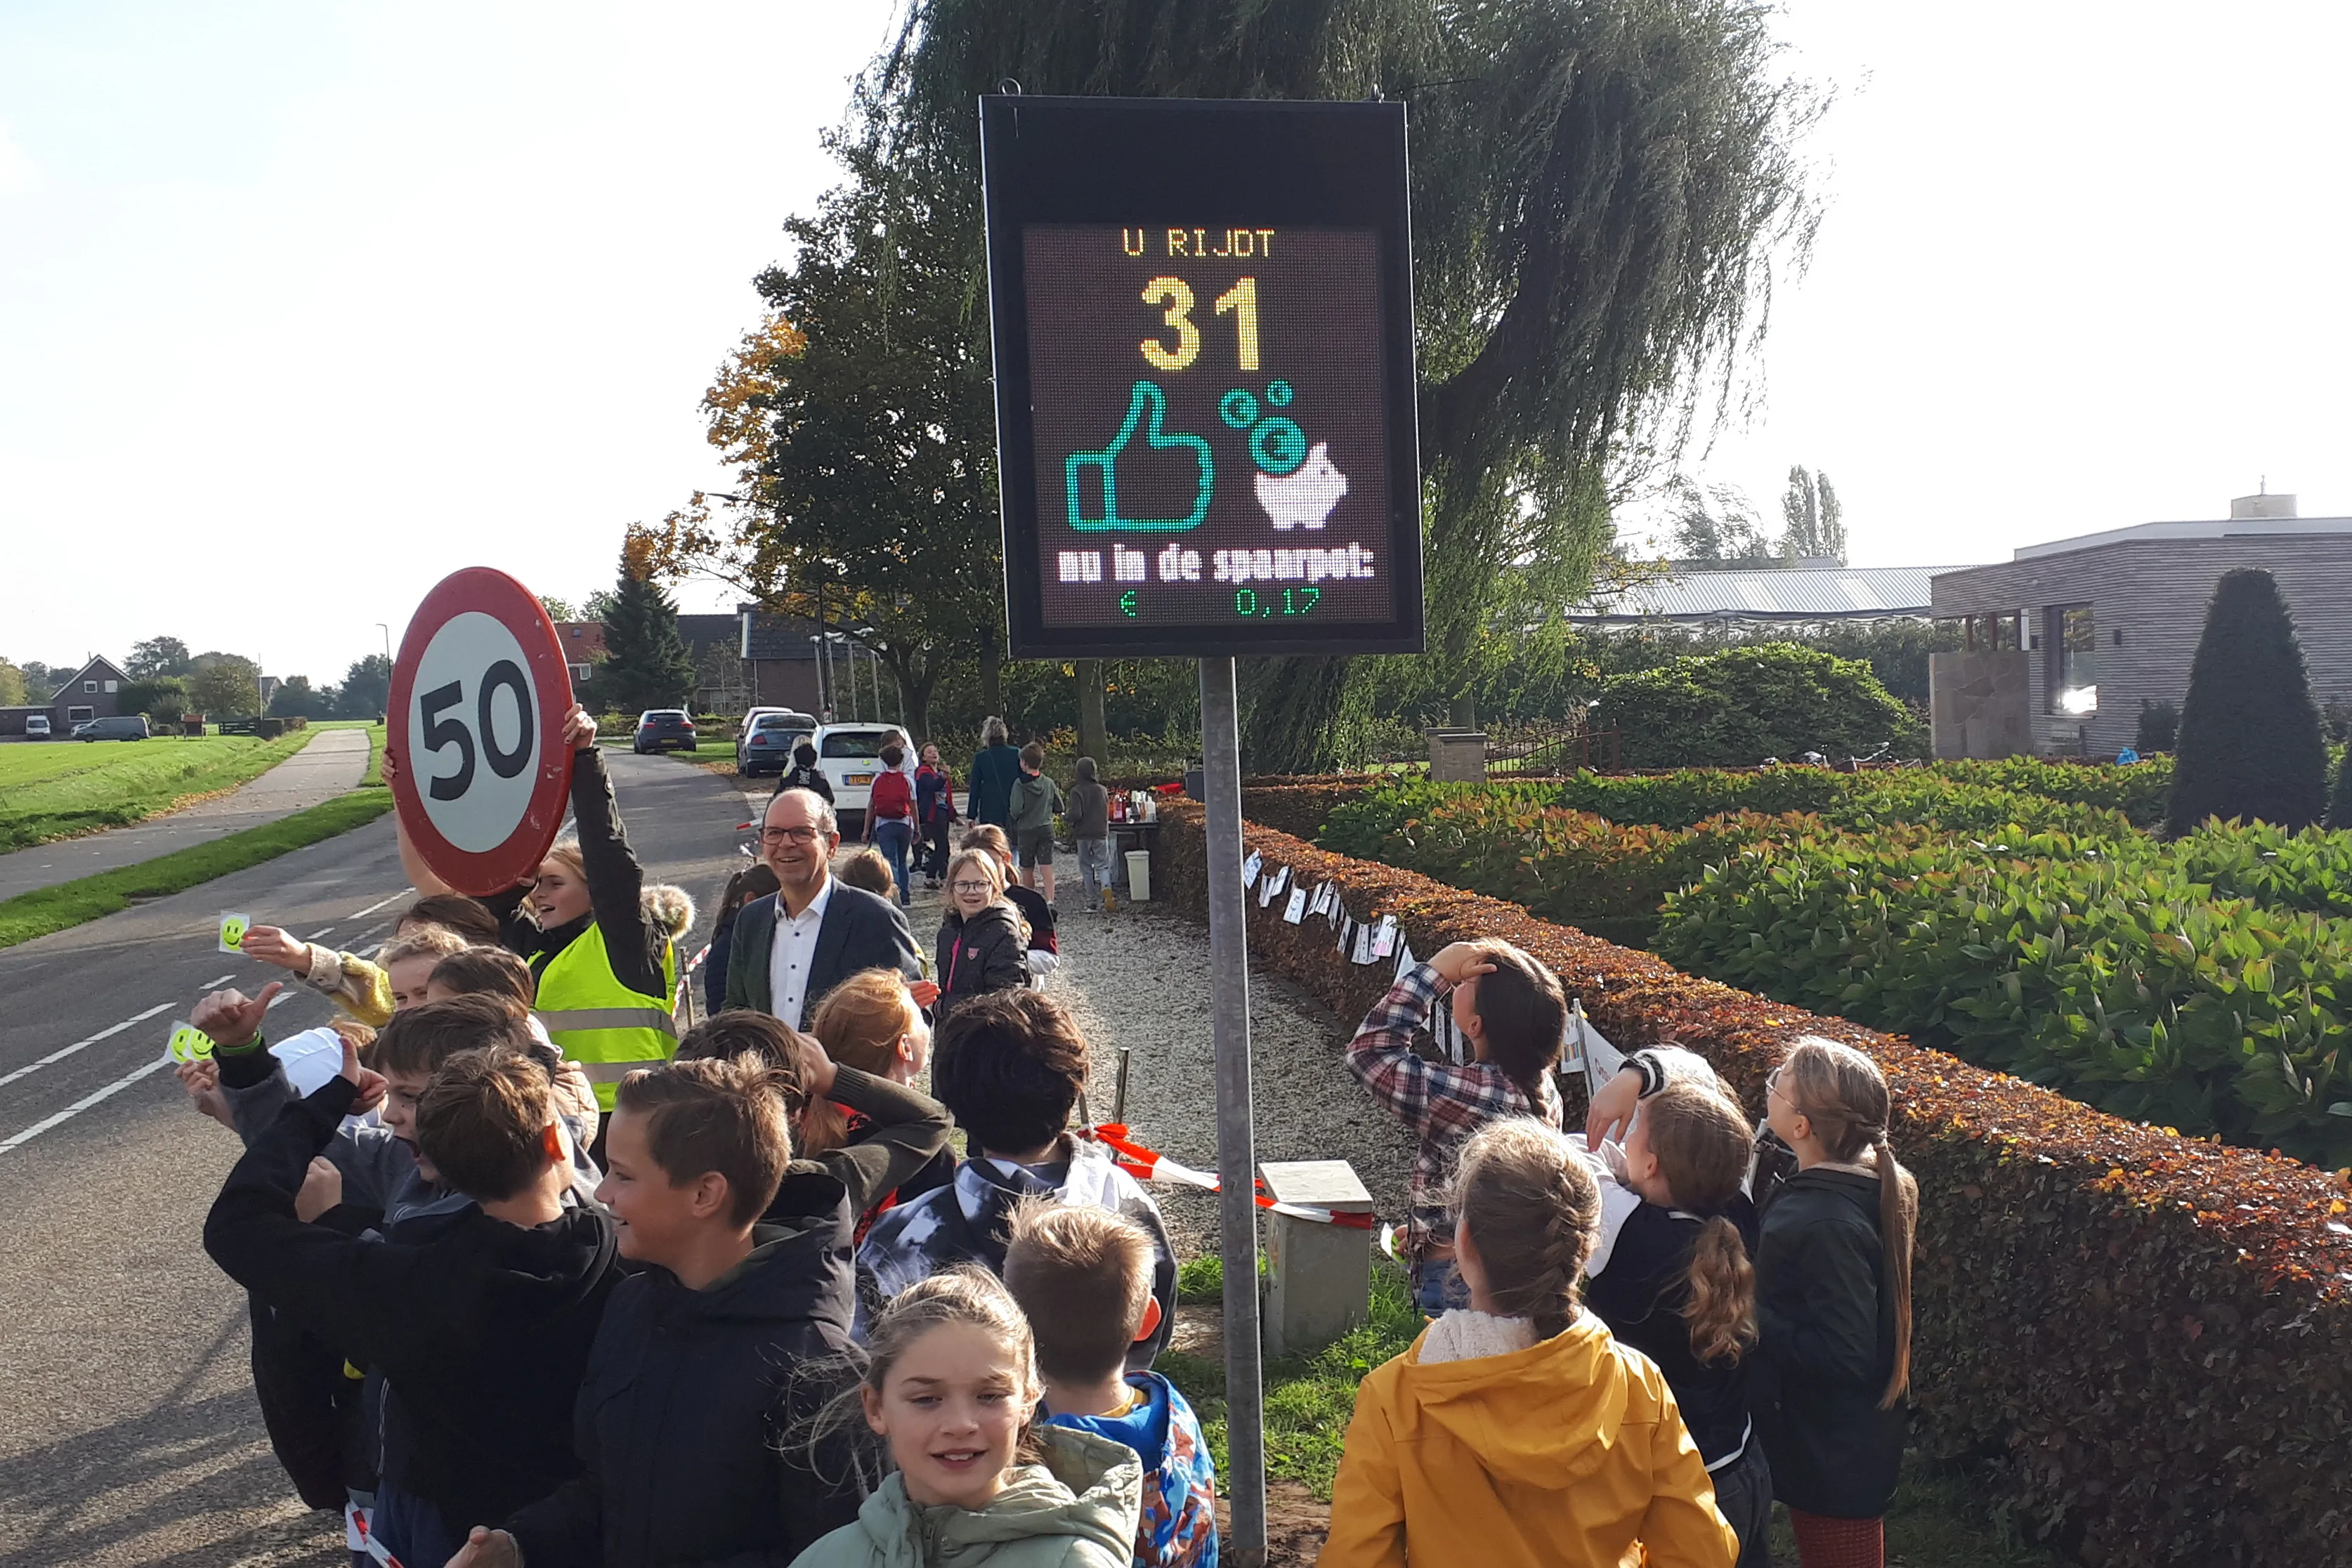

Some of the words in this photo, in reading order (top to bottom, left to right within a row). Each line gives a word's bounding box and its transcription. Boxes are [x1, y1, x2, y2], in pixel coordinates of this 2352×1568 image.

[1123, 228, 1144, 256] U
[1168, 228, 1275, 257] RIJDT
[1140, 275, 1259, 371] 31
[1113, 543, 1146, 582] in
[1156, 542, 1203, 583] de
[1120, 590, 1136, 617] €
[1234, 587, 1321, 618] 0,17
[420, 659, 534, 802] 50
